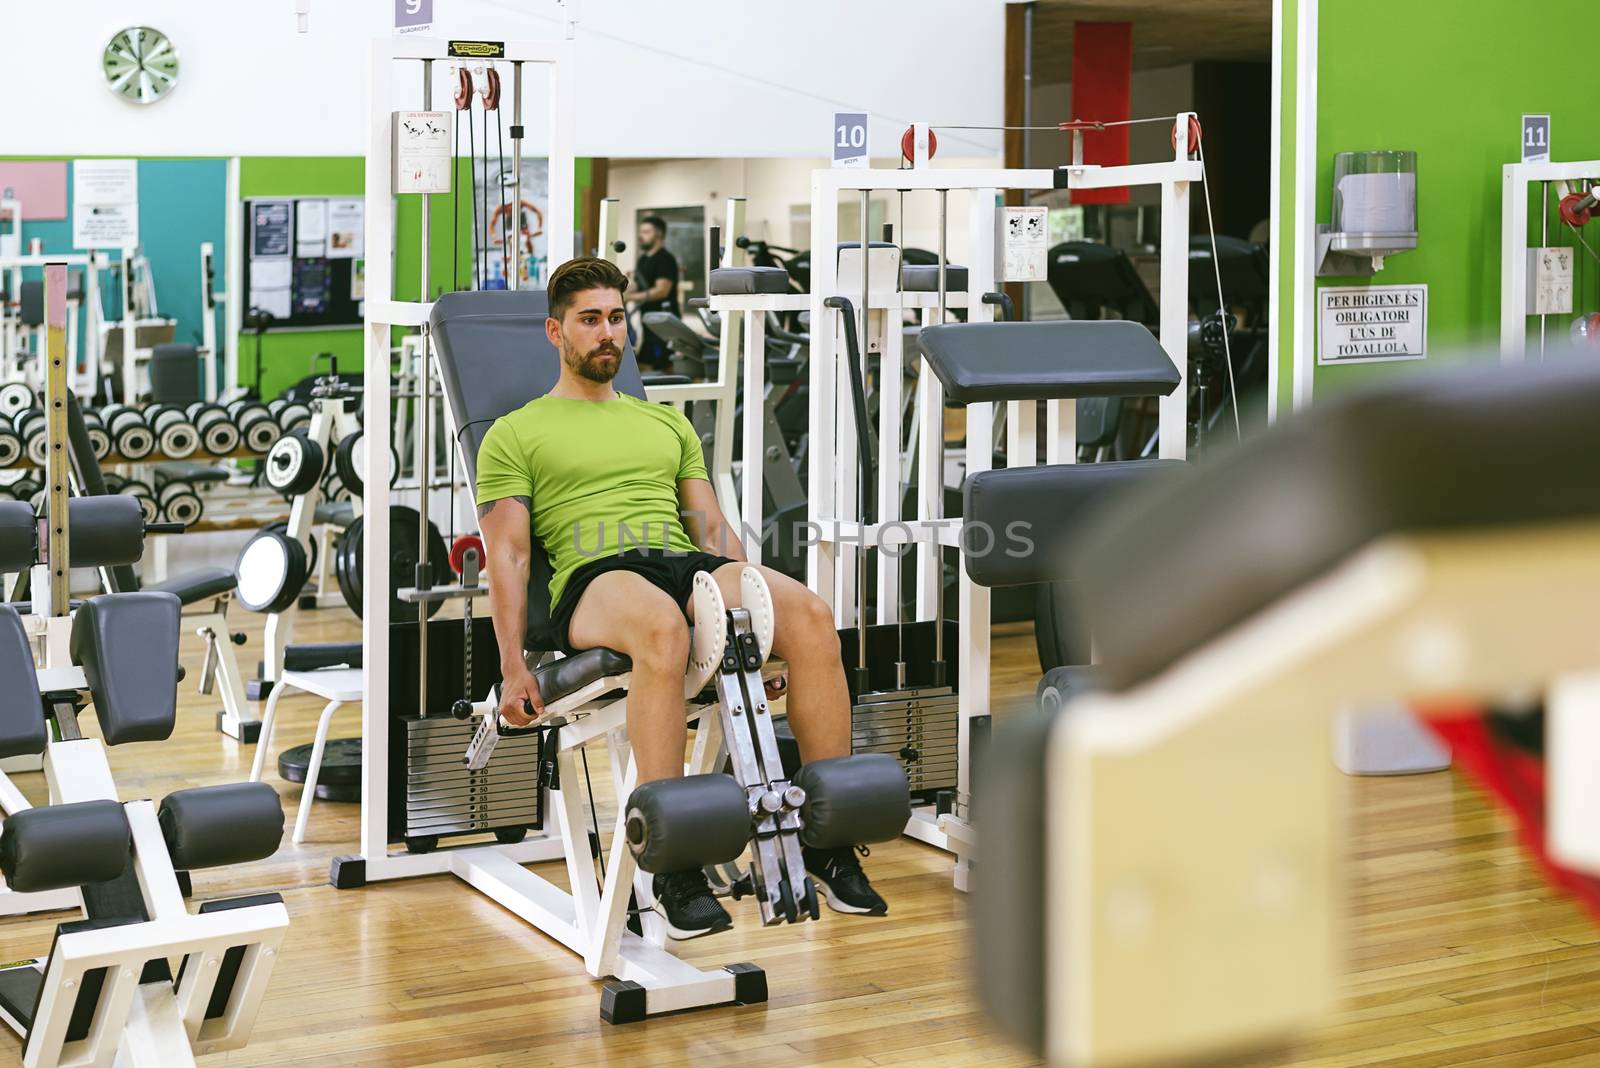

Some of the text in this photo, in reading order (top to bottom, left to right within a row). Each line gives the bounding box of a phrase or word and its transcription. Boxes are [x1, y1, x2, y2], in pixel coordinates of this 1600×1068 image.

[836, 125, 865, 148] 10
[1525, 127, 1546, 147] 11
[1327, 295, 1350, 307] PER
[1352, 294, 1402, 307] HIGIENE
[1335, 310, 1409, 323] OBLIGATORI
[1381, 326, 1396, 338] DE
[1337, 342, 1408, 356] TOVALLOLA
